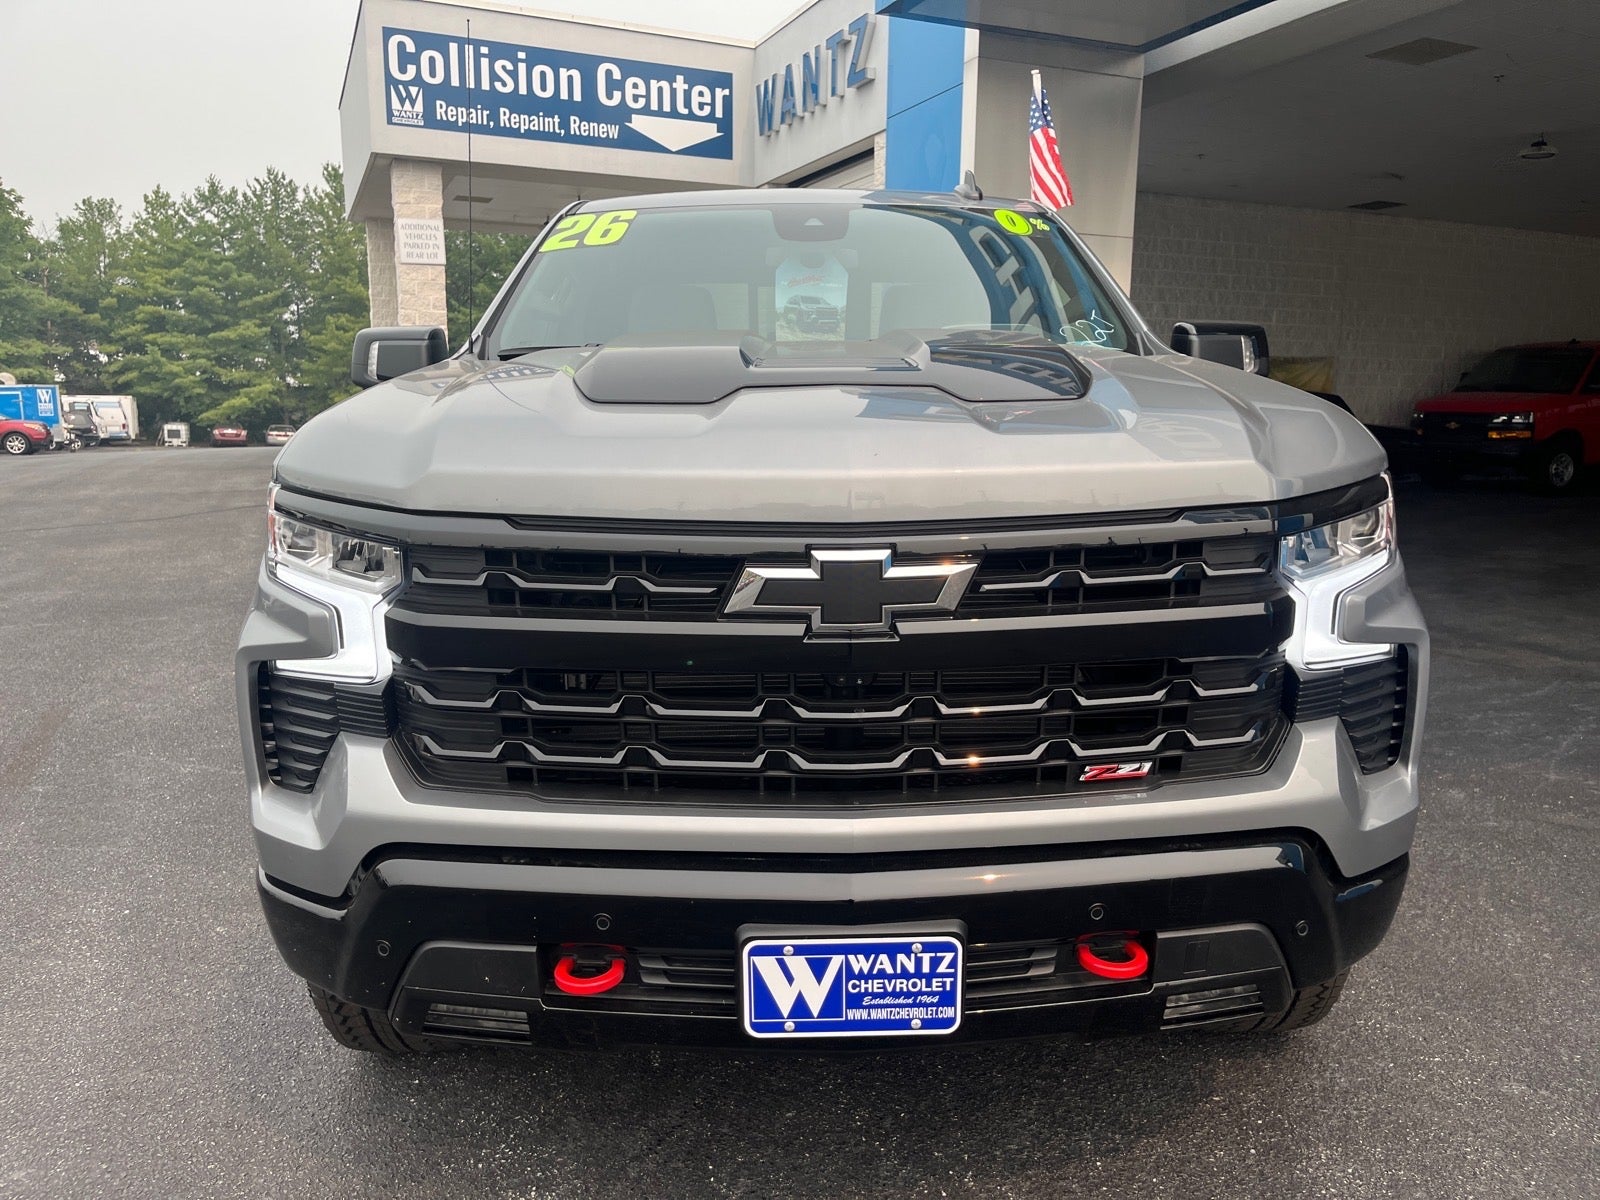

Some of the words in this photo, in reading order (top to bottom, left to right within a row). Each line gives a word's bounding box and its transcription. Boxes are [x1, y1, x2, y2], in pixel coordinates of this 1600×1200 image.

[388, 34, 582, 102] Collision
[596, 62, 730, 119] Center
[756, 13, 875, 137] WANTZ
[392, 109, 424, 120] WANTZ
[435, 100, 495, 129] Repair,
[499, 107, 565, 137] Repaint,
[569, 115, 620, 140] Renew
[400, 223, 441, 232] ADDITIONAL
[539, 210, 638, 252] 26
[405, 233, 438, 241] VEHICLES
[403, 242, 431, 250] PARKED
[432, 243, 440, 251] IN
[406, 251, 425, 260] REAR
[1079, 761, 1153, 781] Z71
[847, 953, 955, 976] WANTZ
[847, 977, 955, 994] CHEVROLET
[862, 995, 914, 1006] Established
[915, 995, 940, 1004] 1964
[846, 1006, 955, 1021] WWW.WANTZCHEVROLET.COM
